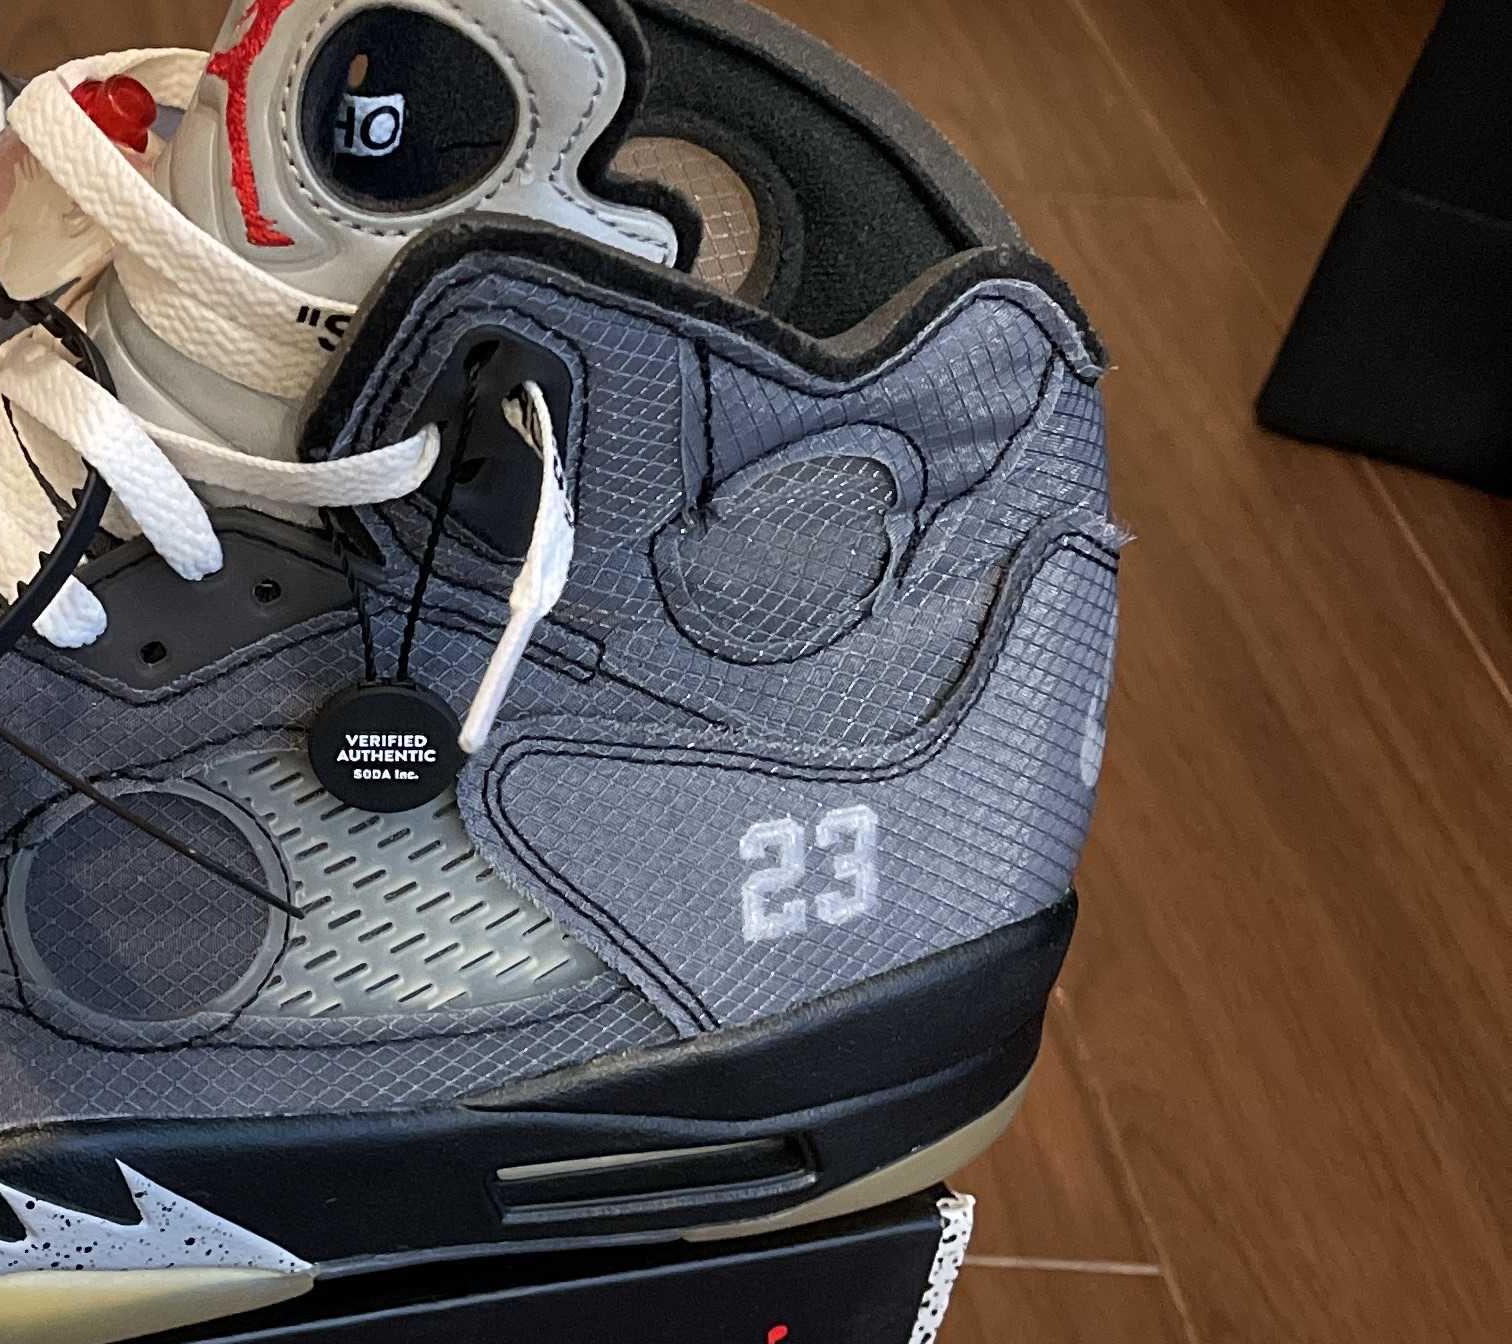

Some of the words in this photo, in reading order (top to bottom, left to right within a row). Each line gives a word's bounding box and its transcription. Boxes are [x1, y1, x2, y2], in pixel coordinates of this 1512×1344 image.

[345, 734, 429, 748] VERIFIED
[336, 749, 438, 763] AUTHENTIC
[353, 768, 392, 780] SODA
[394, 768, 420, 780] Inc.
[739, 804, 880, 943] 23
